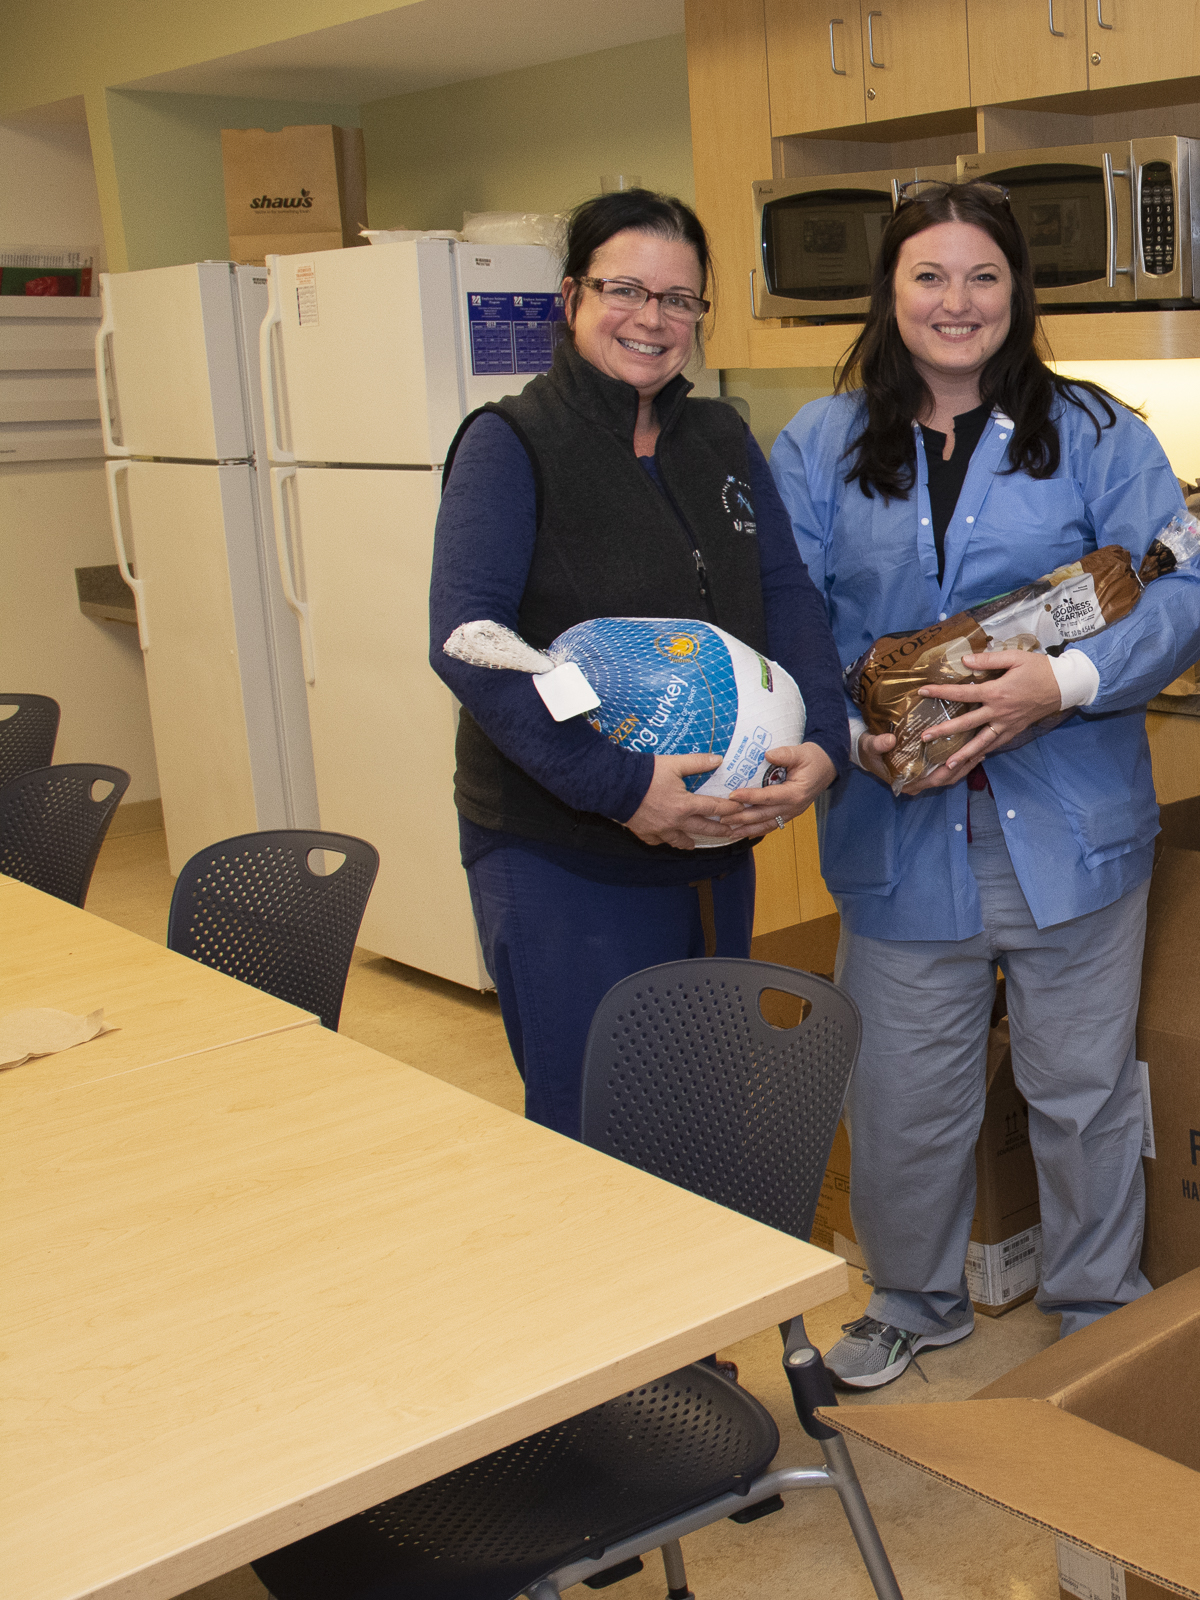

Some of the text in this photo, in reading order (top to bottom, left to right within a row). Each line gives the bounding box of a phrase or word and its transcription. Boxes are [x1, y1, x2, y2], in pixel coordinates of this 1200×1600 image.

[860, 626, 942, 705] OTATOES
[647, 674, 688, 727] turkey
[685, 684, 698, 706] TURKEY
[608, 714, 639, 744] OZEN
